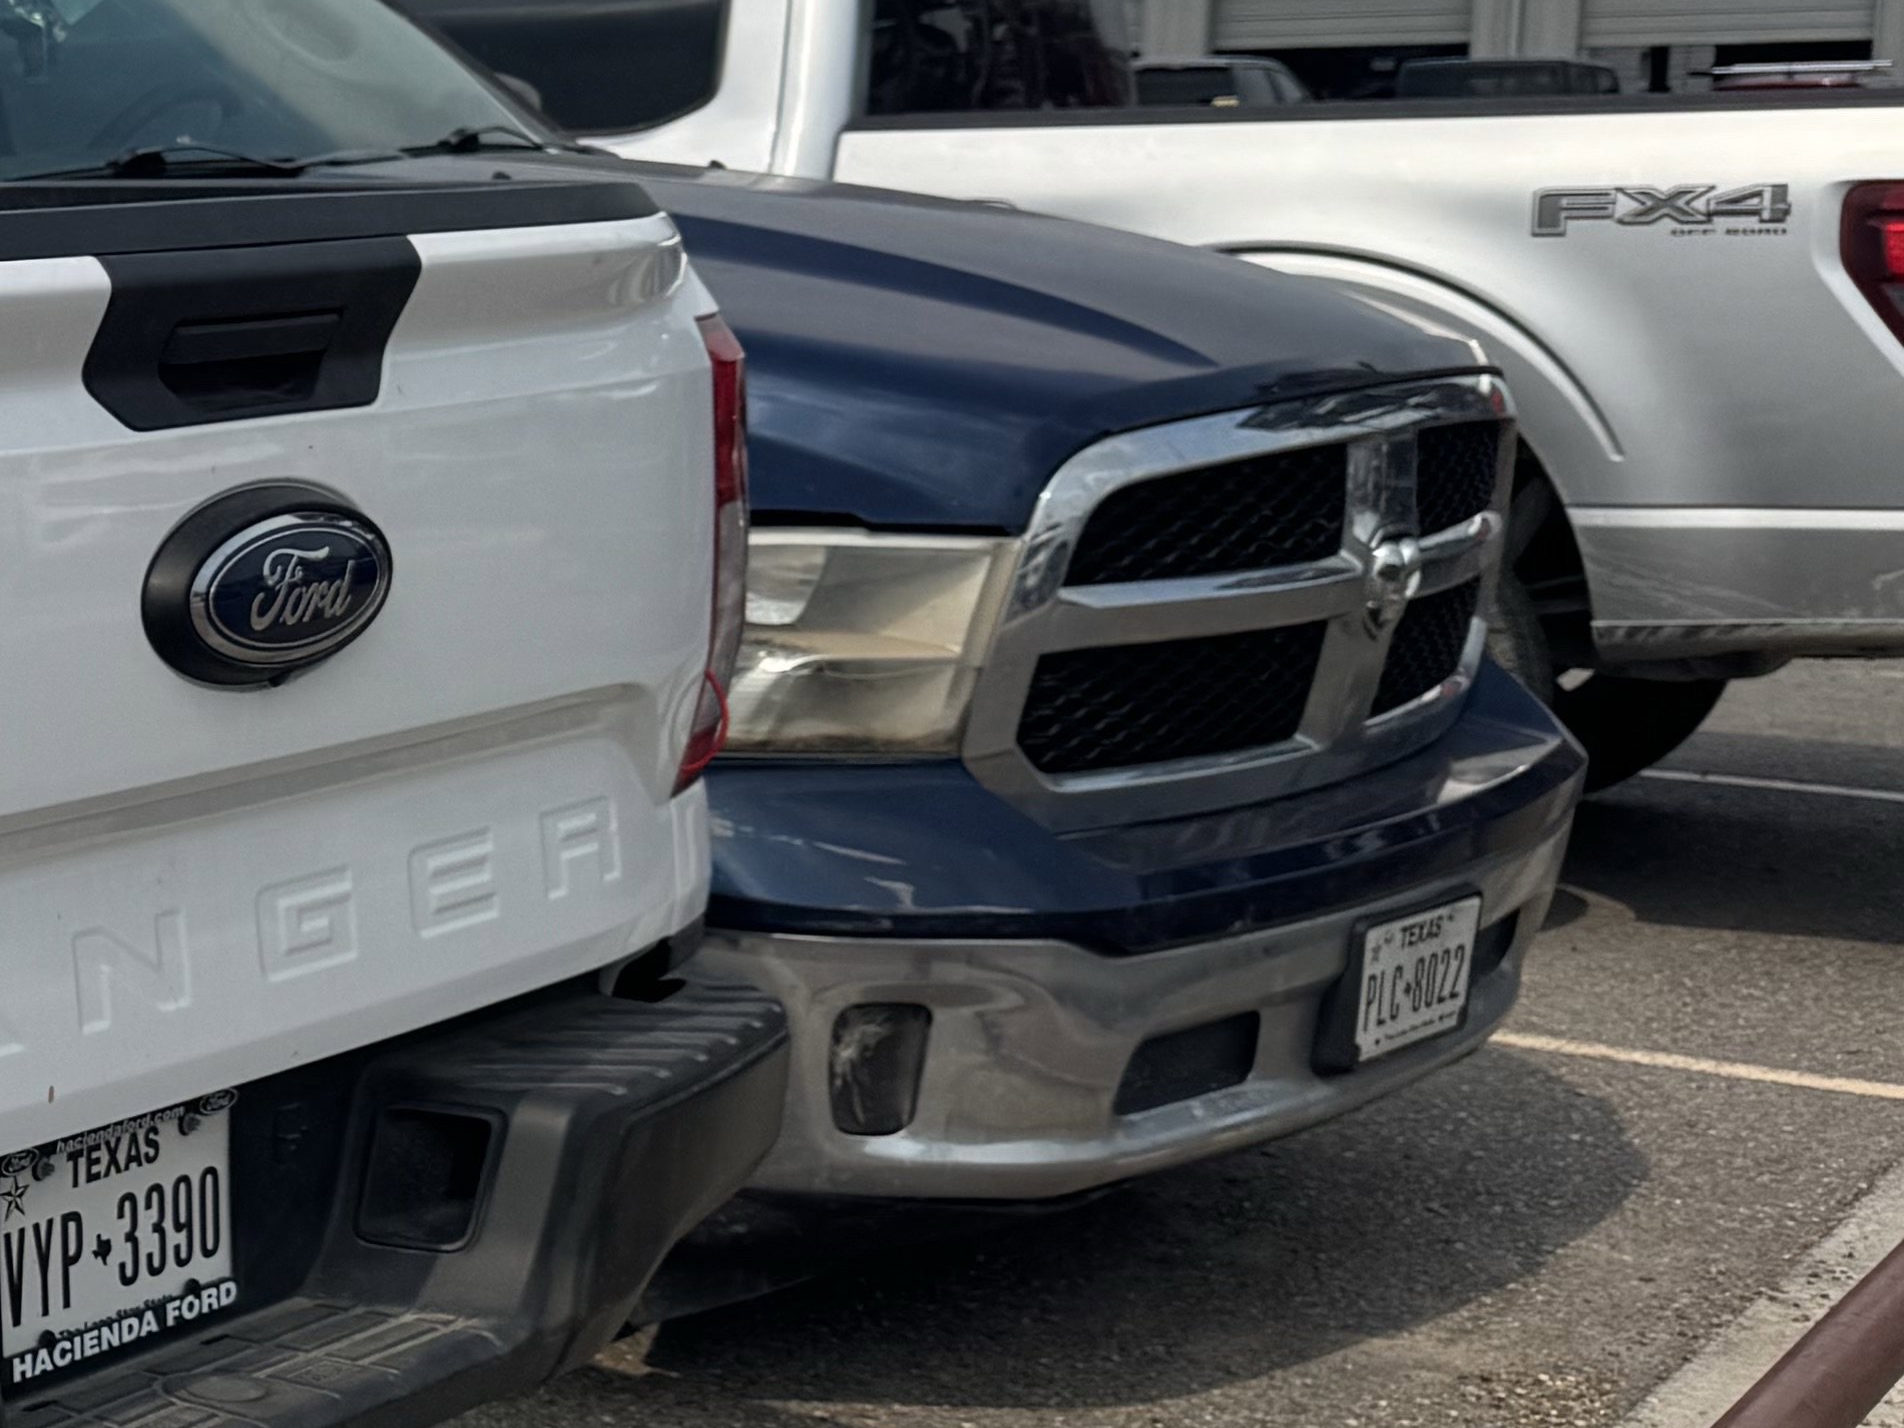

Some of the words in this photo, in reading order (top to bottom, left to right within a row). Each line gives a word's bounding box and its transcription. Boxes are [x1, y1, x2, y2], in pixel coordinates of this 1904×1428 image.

[1531, 183, 1791, 237] FX4
[250, 546, 355, 631] Ford
[1400, 916, 1442, 950] TEXAS
[56, 1106, 185, 1154] haciendaford.com
[66, 1125, 160, 1188] TEXAS
[12, 1309, 160, 1383] HACIENDA
[166, 1280, 238, 1327] FORD
